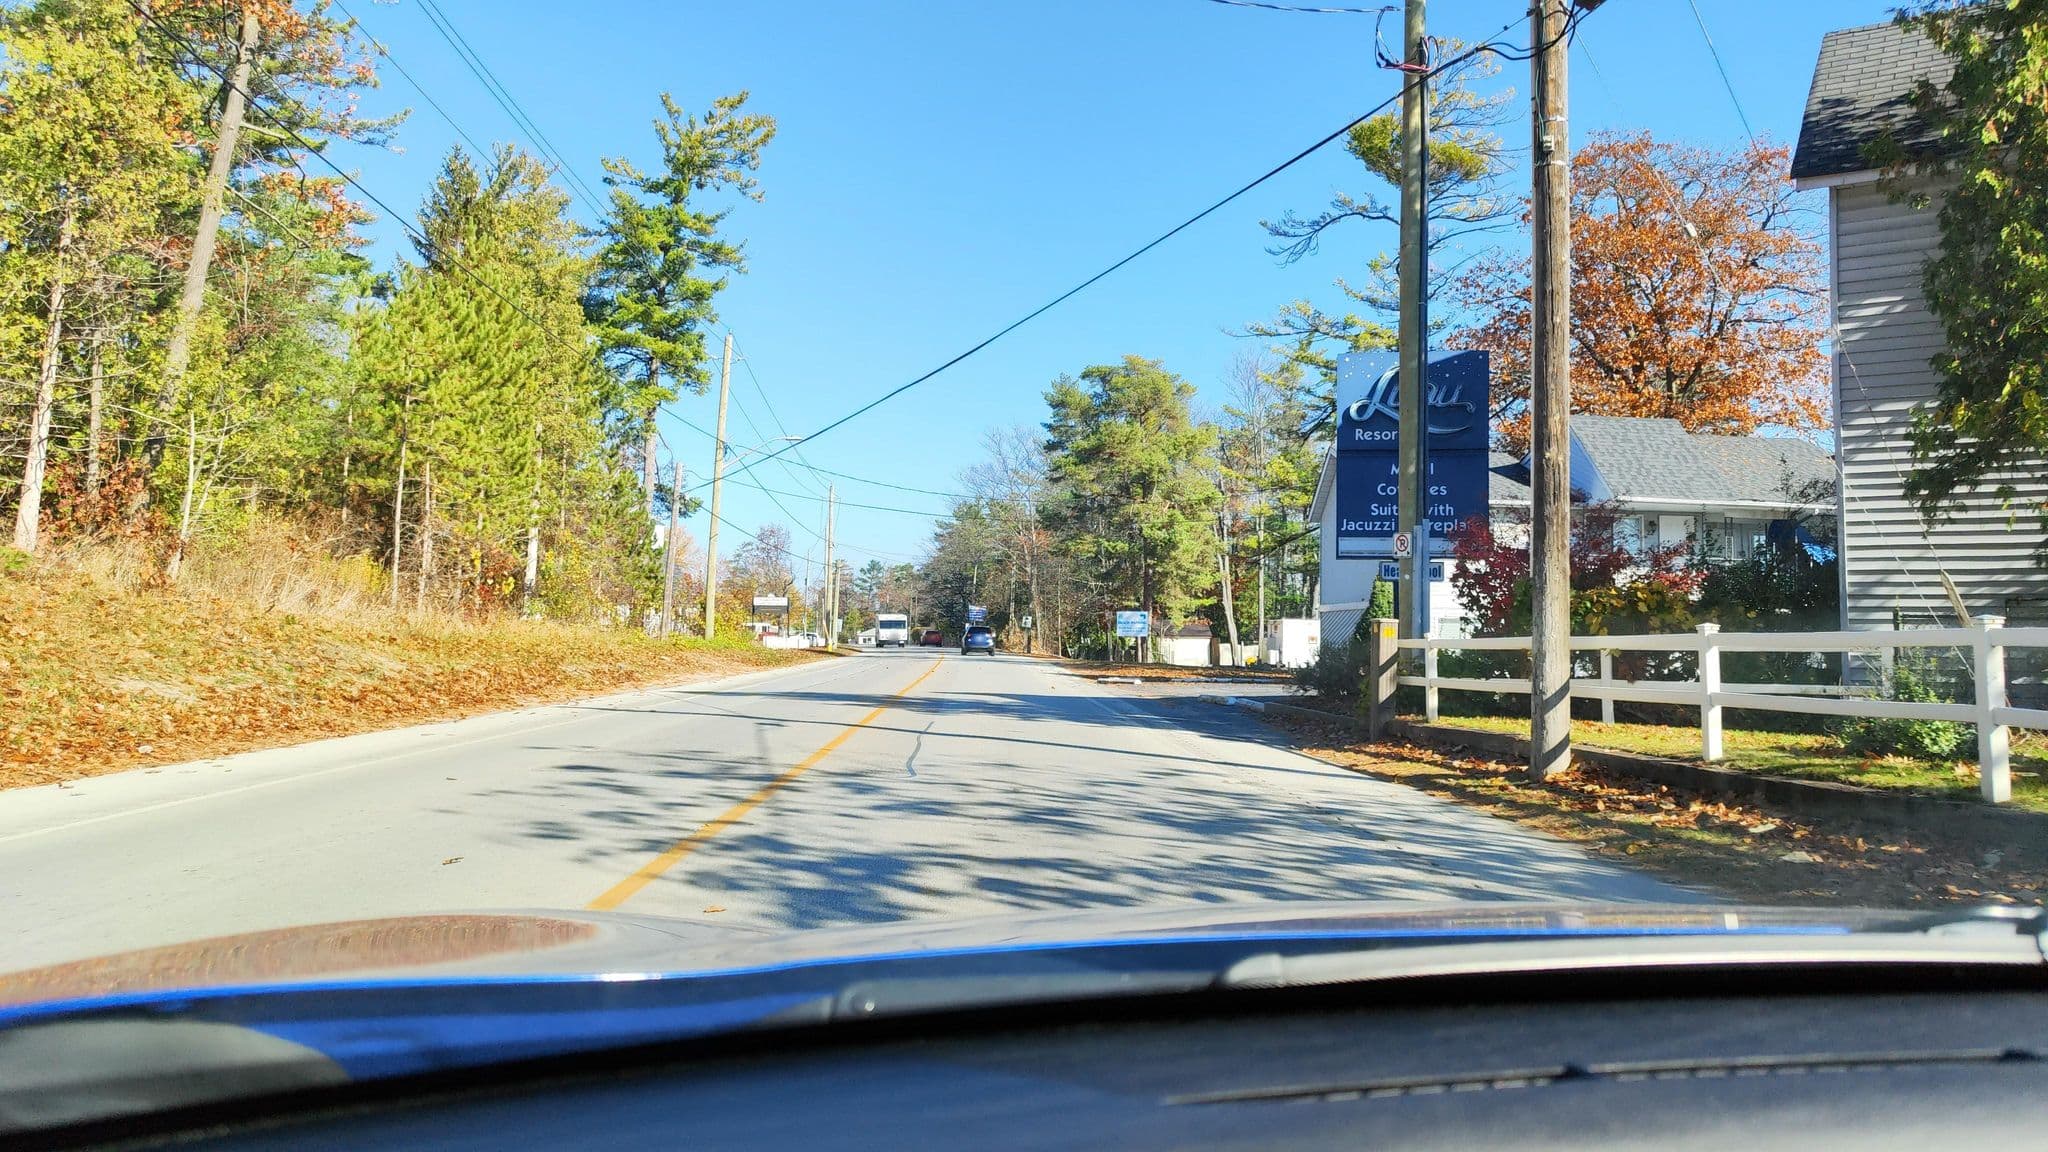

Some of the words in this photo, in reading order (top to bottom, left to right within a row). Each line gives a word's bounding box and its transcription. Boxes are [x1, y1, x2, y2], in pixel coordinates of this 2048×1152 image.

[1355, 428, 1398, 440] Resor
[1377, 483, 1447, 496] Coes
[1371, 503, 1398, 516] Suit
[1341, 518, 1395, 531] Jacuzzi
